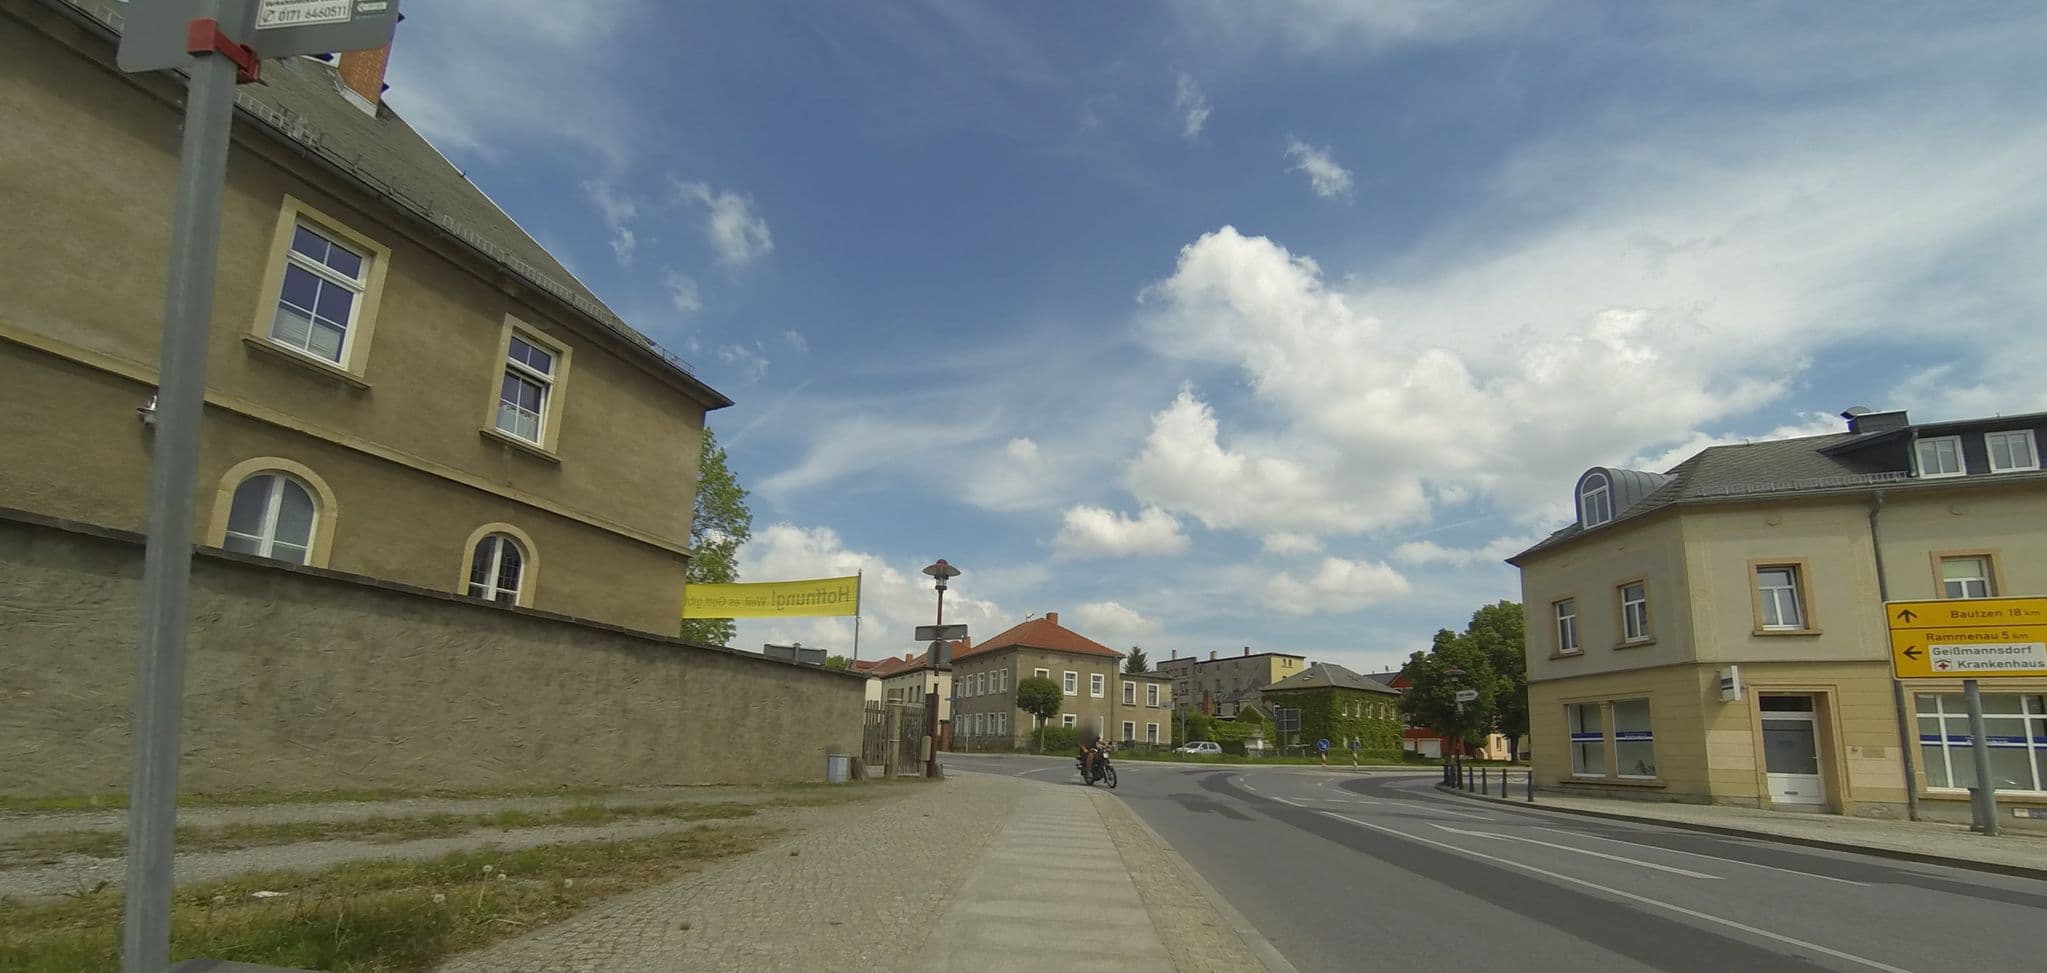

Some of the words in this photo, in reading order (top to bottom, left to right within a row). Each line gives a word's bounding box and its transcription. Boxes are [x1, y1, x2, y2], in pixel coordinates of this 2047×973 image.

[278, 10, 301, 21] 0171
[304, 6, 347, 19] 6460511
[1950, 609, 2003, 619] Bautzen
[2008, 608, 2022, 617] 18
[1926, 632, 1999, 642] Rammenau
[2001, 631, 2010, 640] 5
[1932, 645, 2033, 656] Geißmannsdorf
[1957, 659, 2046, 670] Krankenhaus
